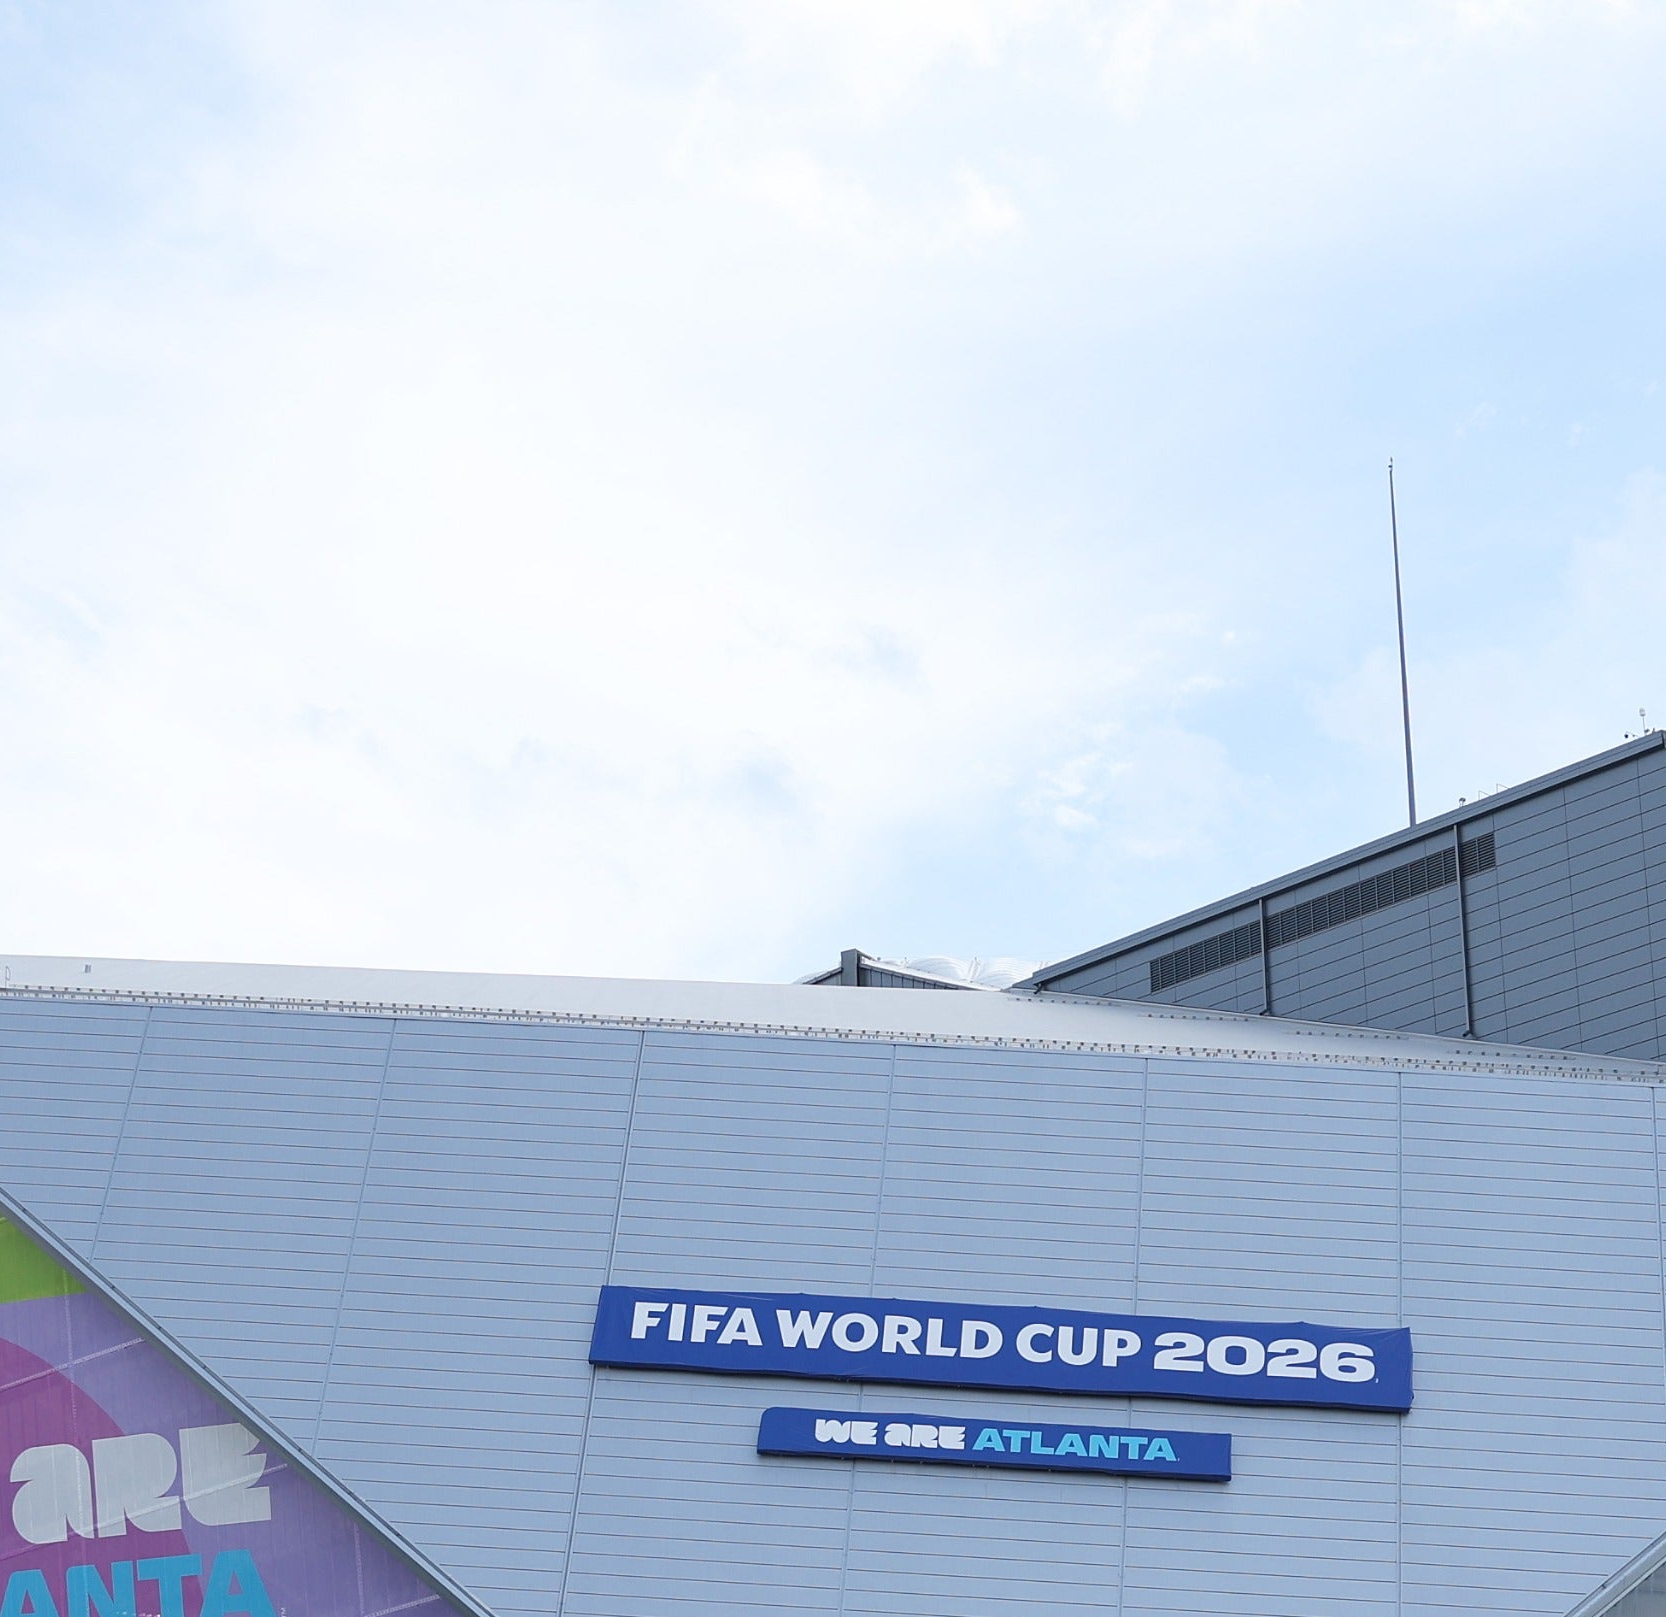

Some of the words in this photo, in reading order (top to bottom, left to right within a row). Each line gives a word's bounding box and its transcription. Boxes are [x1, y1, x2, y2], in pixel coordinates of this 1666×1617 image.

[631, 1301, 763, 1346] FIFA
[776, 1309, 1003, 1359] WORLD
[1016, 1323, 1142, 1367] CUP
[1153, 1332, 1375, 1383] 2026
[815, 1418, 879, 1446] WE
[883, 1423, 966, 1450] ARE
[972, 1427, 1177, 1462] ATLANTA
[9, 1422, 272, 1545] ARE
